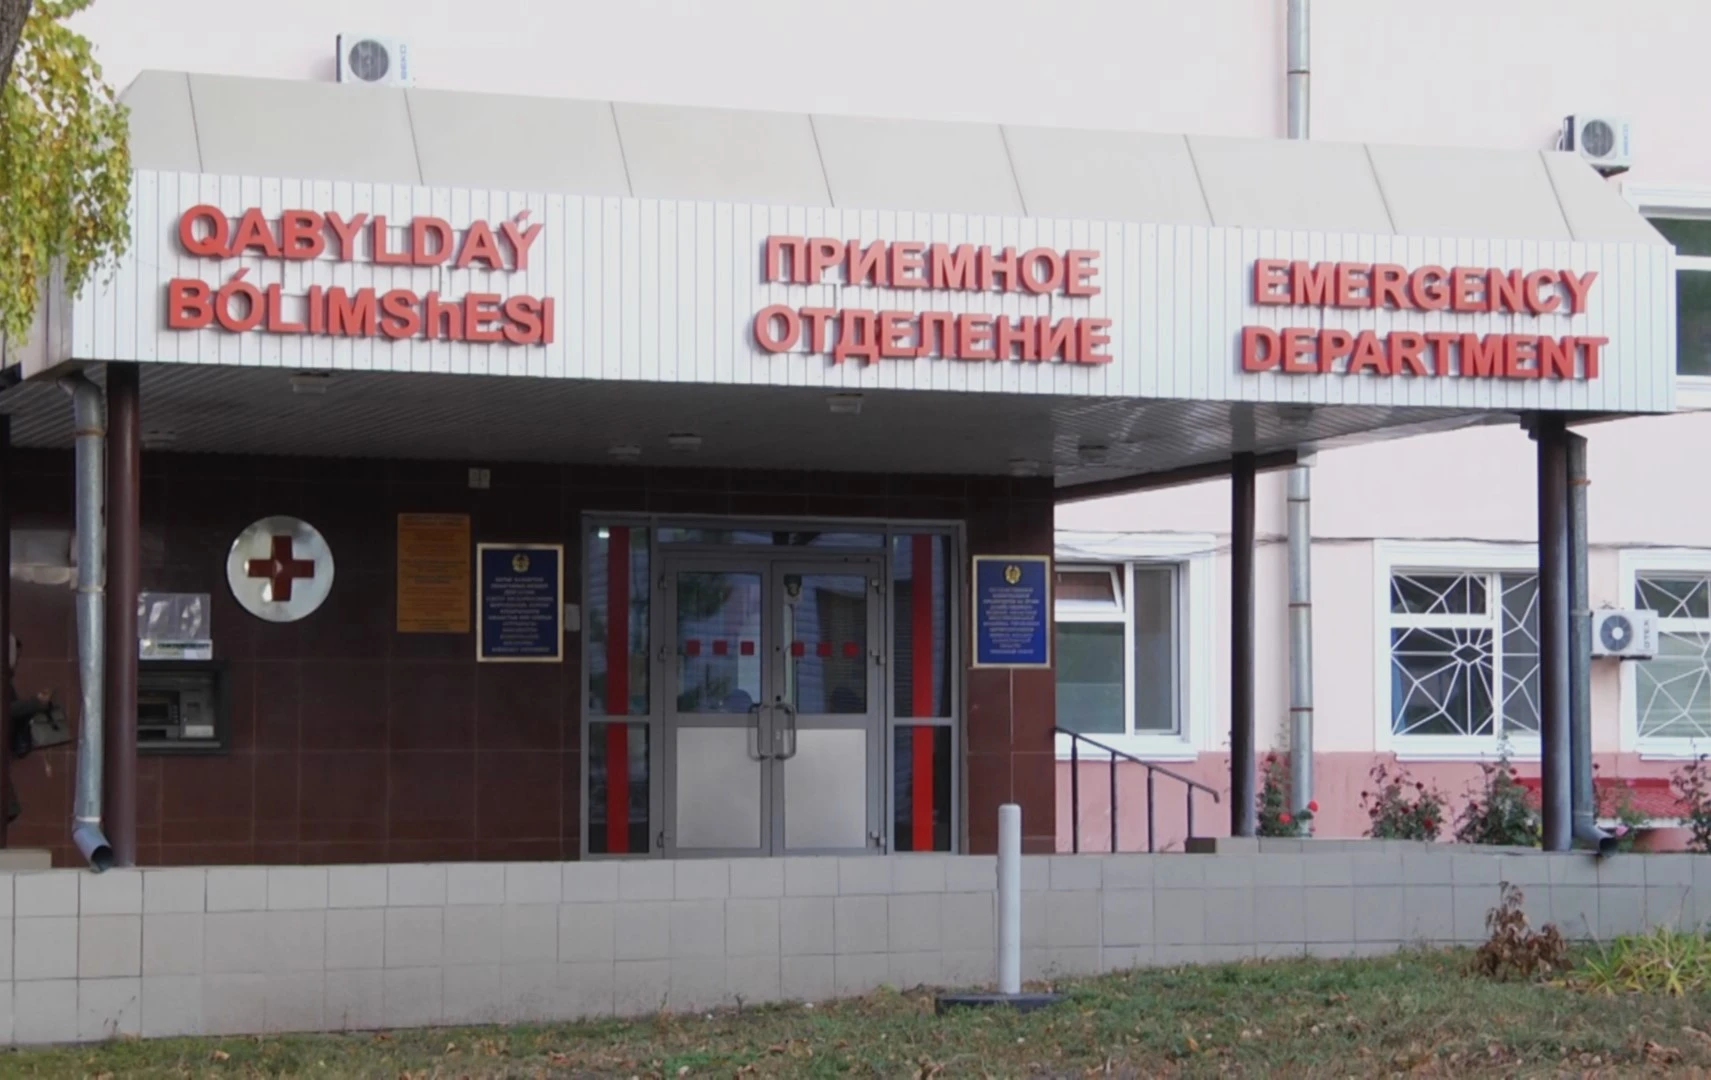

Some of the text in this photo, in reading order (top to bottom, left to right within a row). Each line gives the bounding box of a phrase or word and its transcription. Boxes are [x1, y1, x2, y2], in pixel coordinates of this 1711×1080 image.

[178, 204, 543, 271] QABYLDAÝ
[764, 235, 1101, 295] ПРИЕМНОЕ
[1253, 258, 1599, 314] EMERGENCY
[753, 304, 1113, 366] ОТДЕЛЕНИЕ
[1241, 326, 1608, 379] DEPARTMENT
